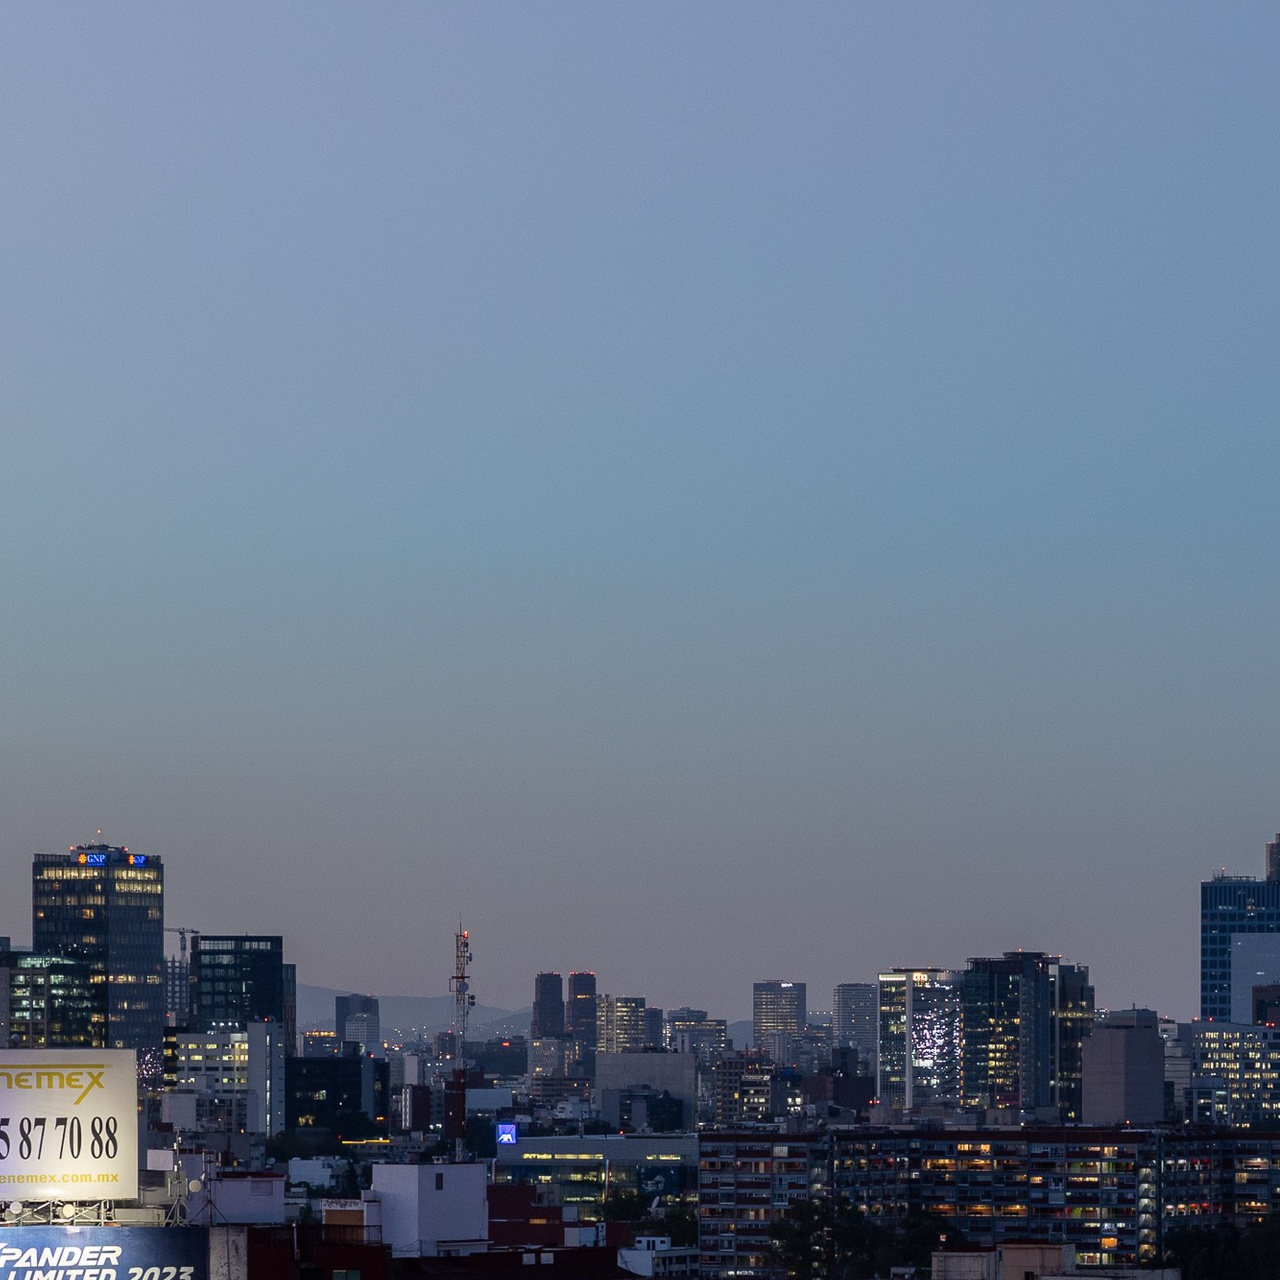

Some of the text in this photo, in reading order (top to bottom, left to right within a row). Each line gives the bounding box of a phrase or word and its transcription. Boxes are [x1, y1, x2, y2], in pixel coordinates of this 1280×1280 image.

[87, 854, 106, 863] GNP
[19, 1117, 47, 1160] 87
[55, 1116, 82, 1159] 70
[91, 1116, 118, 1159] 88
[0, 1243, 123, 1268] PANDER
